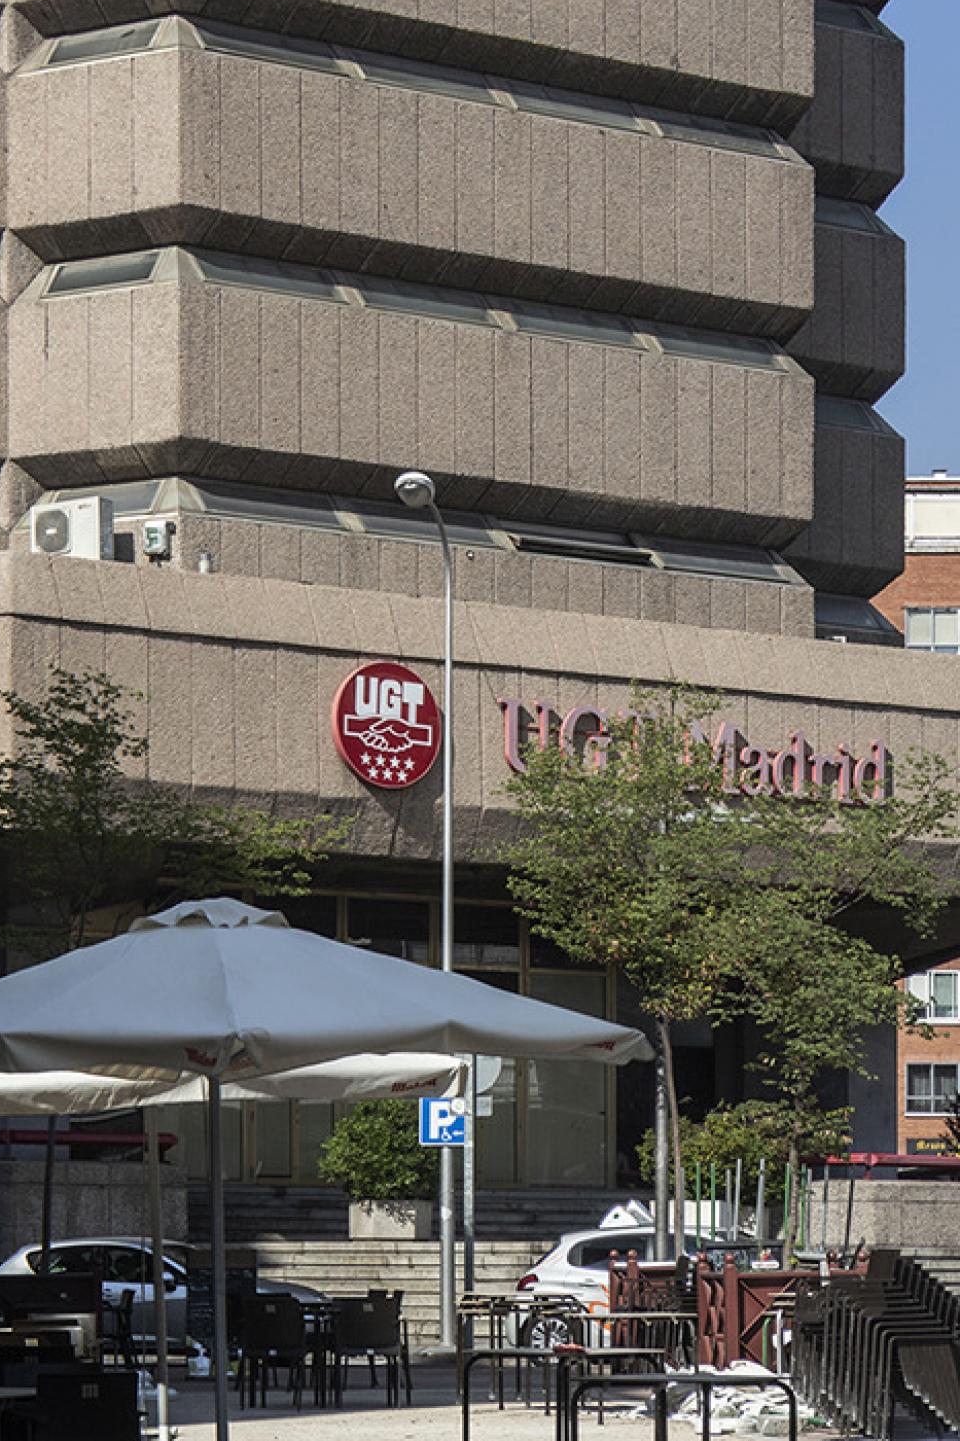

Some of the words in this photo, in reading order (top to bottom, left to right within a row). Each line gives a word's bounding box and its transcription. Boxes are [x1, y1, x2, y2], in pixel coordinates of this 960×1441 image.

[356, 675, 424, 725] UGT
[683, 721, 886, 803] Madrid
[429, 1101, 457, 1139] P
